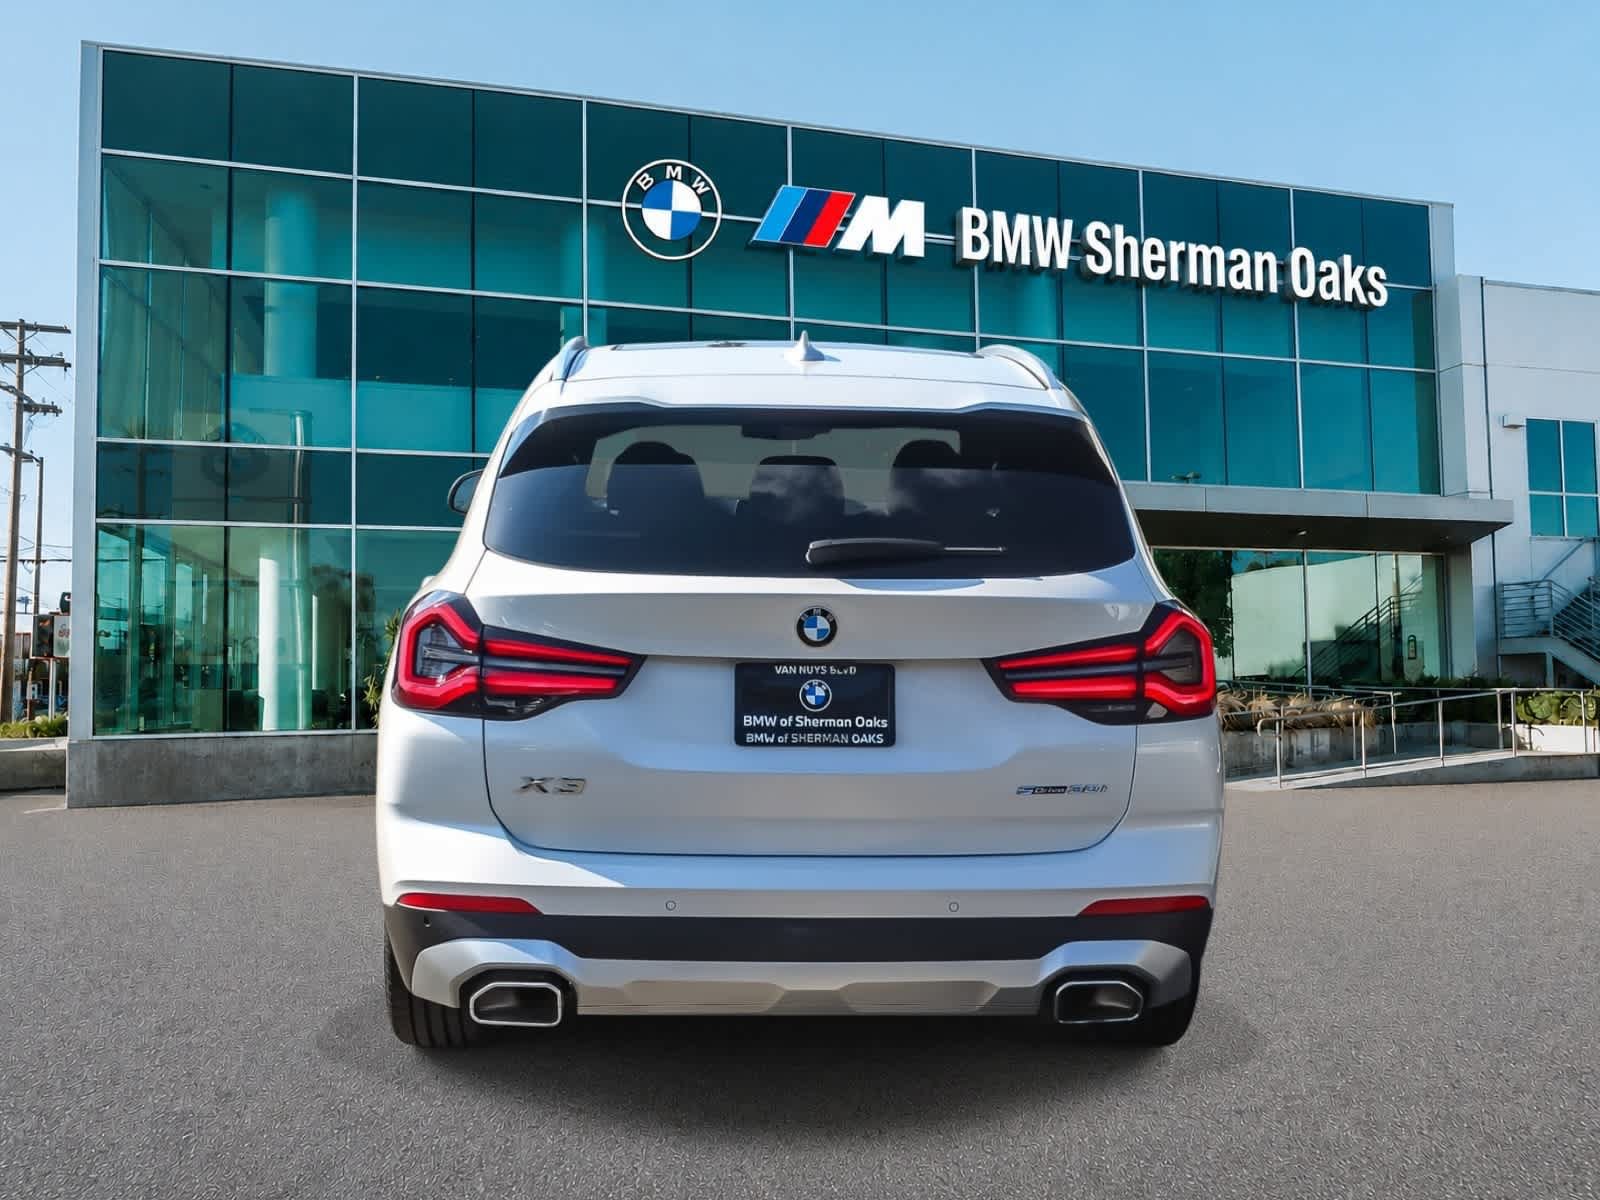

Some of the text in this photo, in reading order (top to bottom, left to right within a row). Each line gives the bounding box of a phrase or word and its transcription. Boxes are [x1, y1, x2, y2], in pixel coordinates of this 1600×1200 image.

[636, 165, 711, 195] BMW
[960, 206, 1389, 308] BMW Sherman Oaks
[774, 665, 797, 675] VAN
[799, 665, 827, 675] NUYS
[743, 715, 888, 728] BMW of Sherman Oaks
[746, 733, 884, 744] BMW of SHERMAN OAKS
[519, 776, 587, 793] X3
